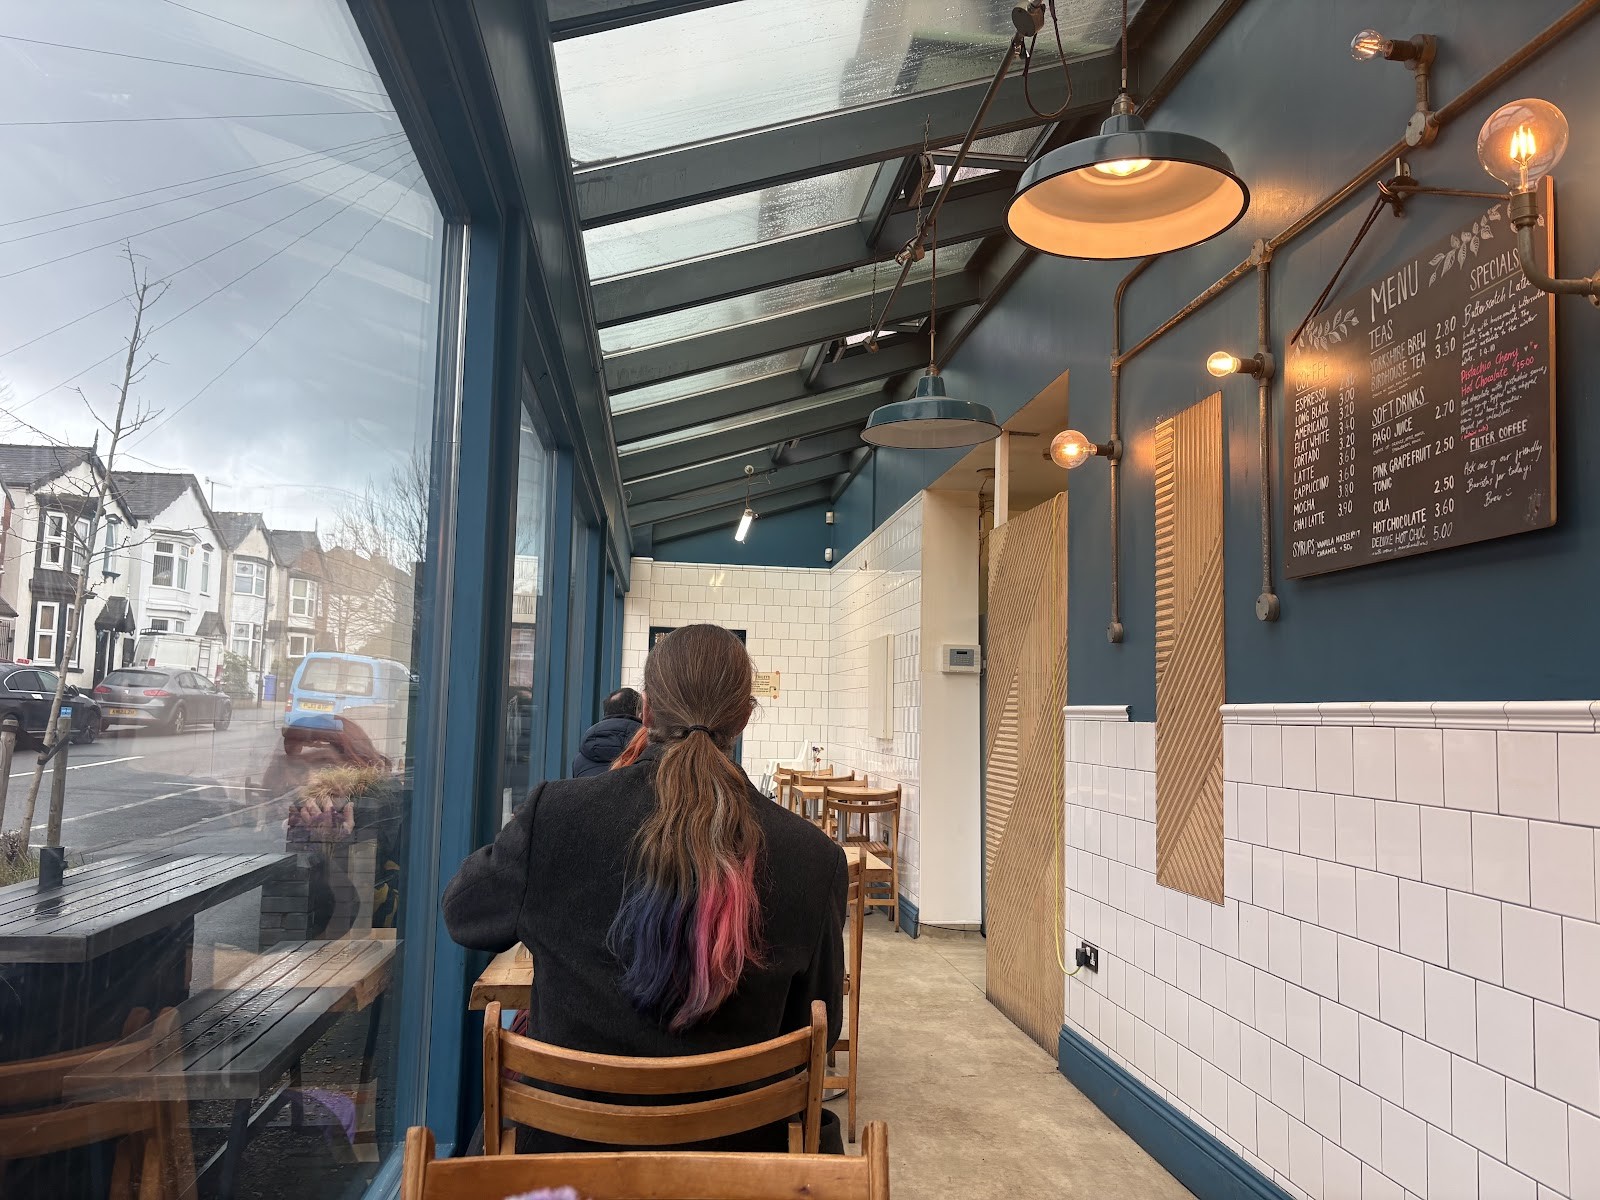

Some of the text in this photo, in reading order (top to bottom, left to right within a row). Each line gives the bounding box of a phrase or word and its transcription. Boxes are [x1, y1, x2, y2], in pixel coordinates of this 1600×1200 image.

[1469, 247, 1520, 292] SPECIALS
[1370, 260, 1419, 323] MENU
[1462, 272, 1532, 328] Butterscotch Latte
[1368, 318, 1394, 350] TEAS
[1369, 315, 1457, 375] YORKSHIRE BREW 2.80
[1371, 359, 1408, 392] BIRDHOUSE
[1410, 351, 1427, 371] TEA
[1435, 336, 1456, 360] 3.30
[1460, 347, 1519, 383] Pistachio Cherry
[1461, 379, 1473, 398] Hot
[1475, 363, 1509, 390] Chocolate
[1295, 386, 1327, 413] ESPRESSO
[1295, 387, 1355, 428] LONG BLACK 3.00
[1371, 399, 1394, 427] SOFT
[1395, 385, 1425, 416] DRINKS
[1294, 401, 1355, 441] AMERICANO 3.20
[1372, 399, 1455, 448] PAGO JUICE 2.70
[1469, 418, 1529, 452] FILTER COFFEE
[1293, 432, 1355, 469] CORTADO 3.20
[1294, 439, 1309, 456] FLAT
[1310, 428, 1330, 448] WHITE
[1372, 435, 1455, 480] PINK GRAPEFRUIT 2.50
[1463, 460, 1476, 476] Ask
[1477, 460, 1489, 470] one
[1499, 452, 1513, 462] our
[1514, 439, 1543, 465] friendly
[1293, 446, 1356, 485] LATTE 3.60
[1293, 463, 1355, 501] CAPPUCCINO 3.60
[1465, 475, 1494, 494] Baristas
[1494, 472, 1506, 489] for
[1293, 481, 1354, 516] MOCHA 3.80
[1372, 477, 1393, 495] TONIC
[1373, 475, 1455, 514] COLA 2.50
[1483, 490, 1503, 508] Brew
[1293, 499, 1353, 532] CHAI LATTE 3.90
[1372, 497, 1455, 535] HOT CHOCOLATE 3.60
[1316, 546, 1338, 558] CARAMEL
[1371, 521, 1453, 549] DELUXE HOT CHOC 5.00
